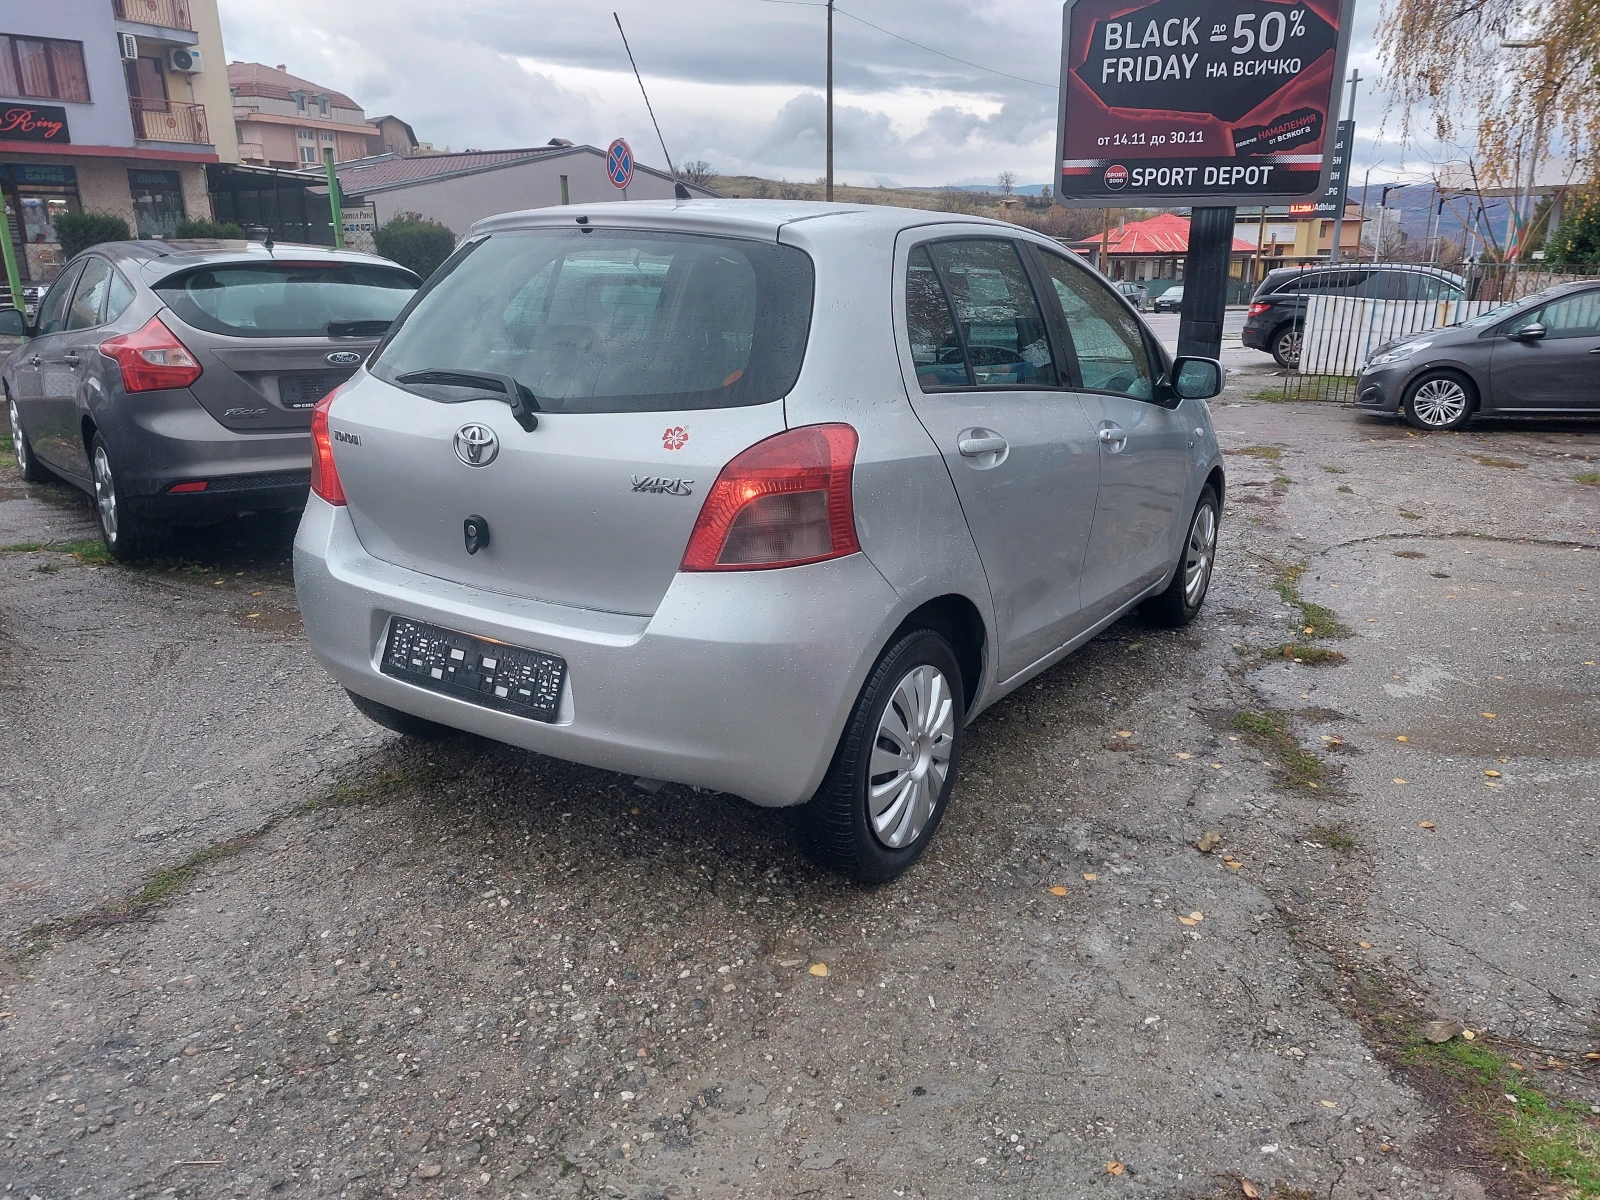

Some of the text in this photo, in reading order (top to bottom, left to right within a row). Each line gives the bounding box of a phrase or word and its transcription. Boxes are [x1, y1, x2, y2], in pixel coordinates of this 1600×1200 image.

[1104, 16, 1201, 51] BLACK
[1211, 23, 1227, 36] до
[1102, 52, 1199, 84] FRIDAY
[1205, 58, 1302, 78] НА ВСИЧКО
[0, 108, 64, 138] Ring
[1257, 113, 1317, 140] НАМАЛЕНИЯ
[1097, 130, 1204, 147] от 14.11 до 30.11
[1269, 137, 1277, 145] от
[26, 173, 65, 182] GAMES
[1131, 165, 1274, 187] SPORT DEPOT
